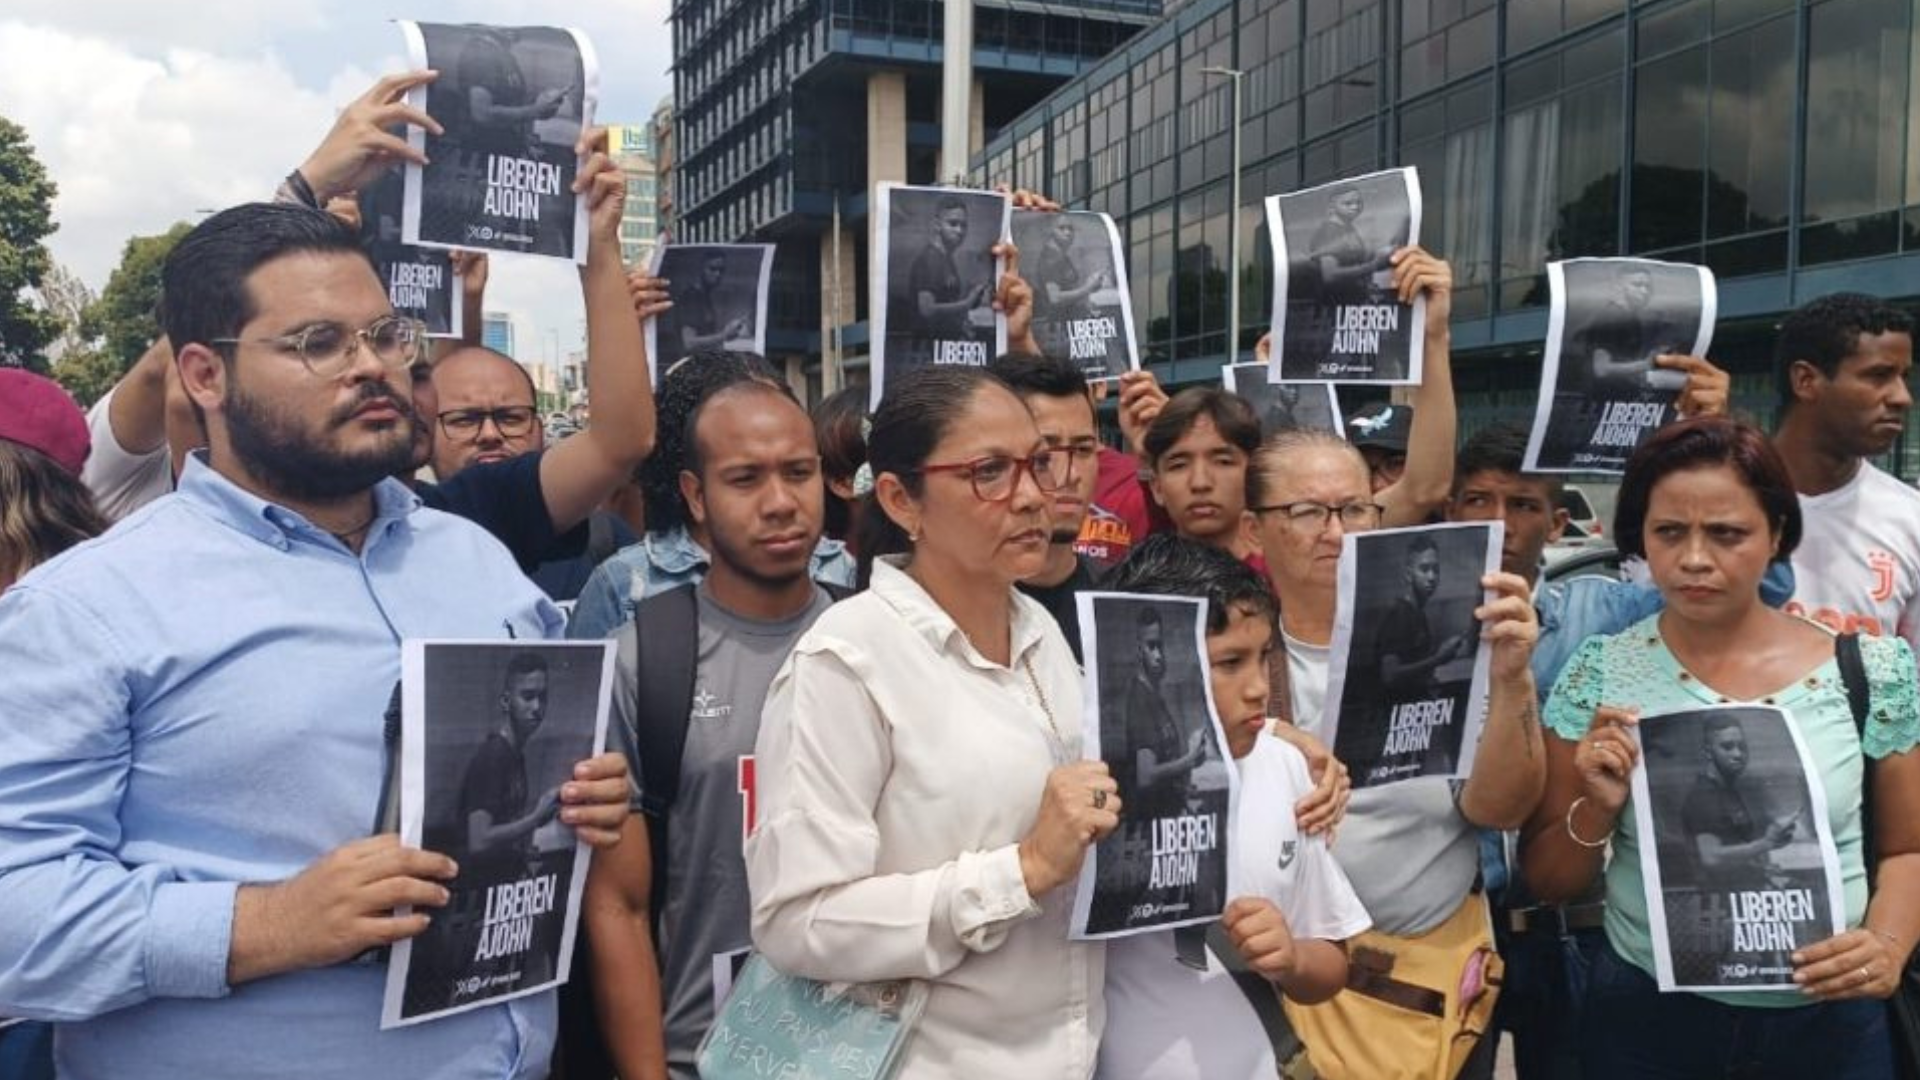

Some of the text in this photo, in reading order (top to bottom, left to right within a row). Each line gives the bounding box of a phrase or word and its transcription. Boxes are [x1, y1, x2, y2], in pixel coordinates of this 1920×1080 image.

[487, 154, 561, 195] LIBEREN
[391, 261, 443, 289] LIBEREN
[1066, 317, 1117, 340] LIBEREN
[1336, 305, 1398, 331] LIBEREN
[934, 340, 987, 366] LIBEREN
[1601, 401, 1666, 428] LIBEREN
[1389, 697, 1454, 732] LIBEREN
[1152, 812, 1217, 856] LIBEREN
[484, 873, 557, 927] LIBEREN
[1730, 889, 1815, 923] LIBEREN
